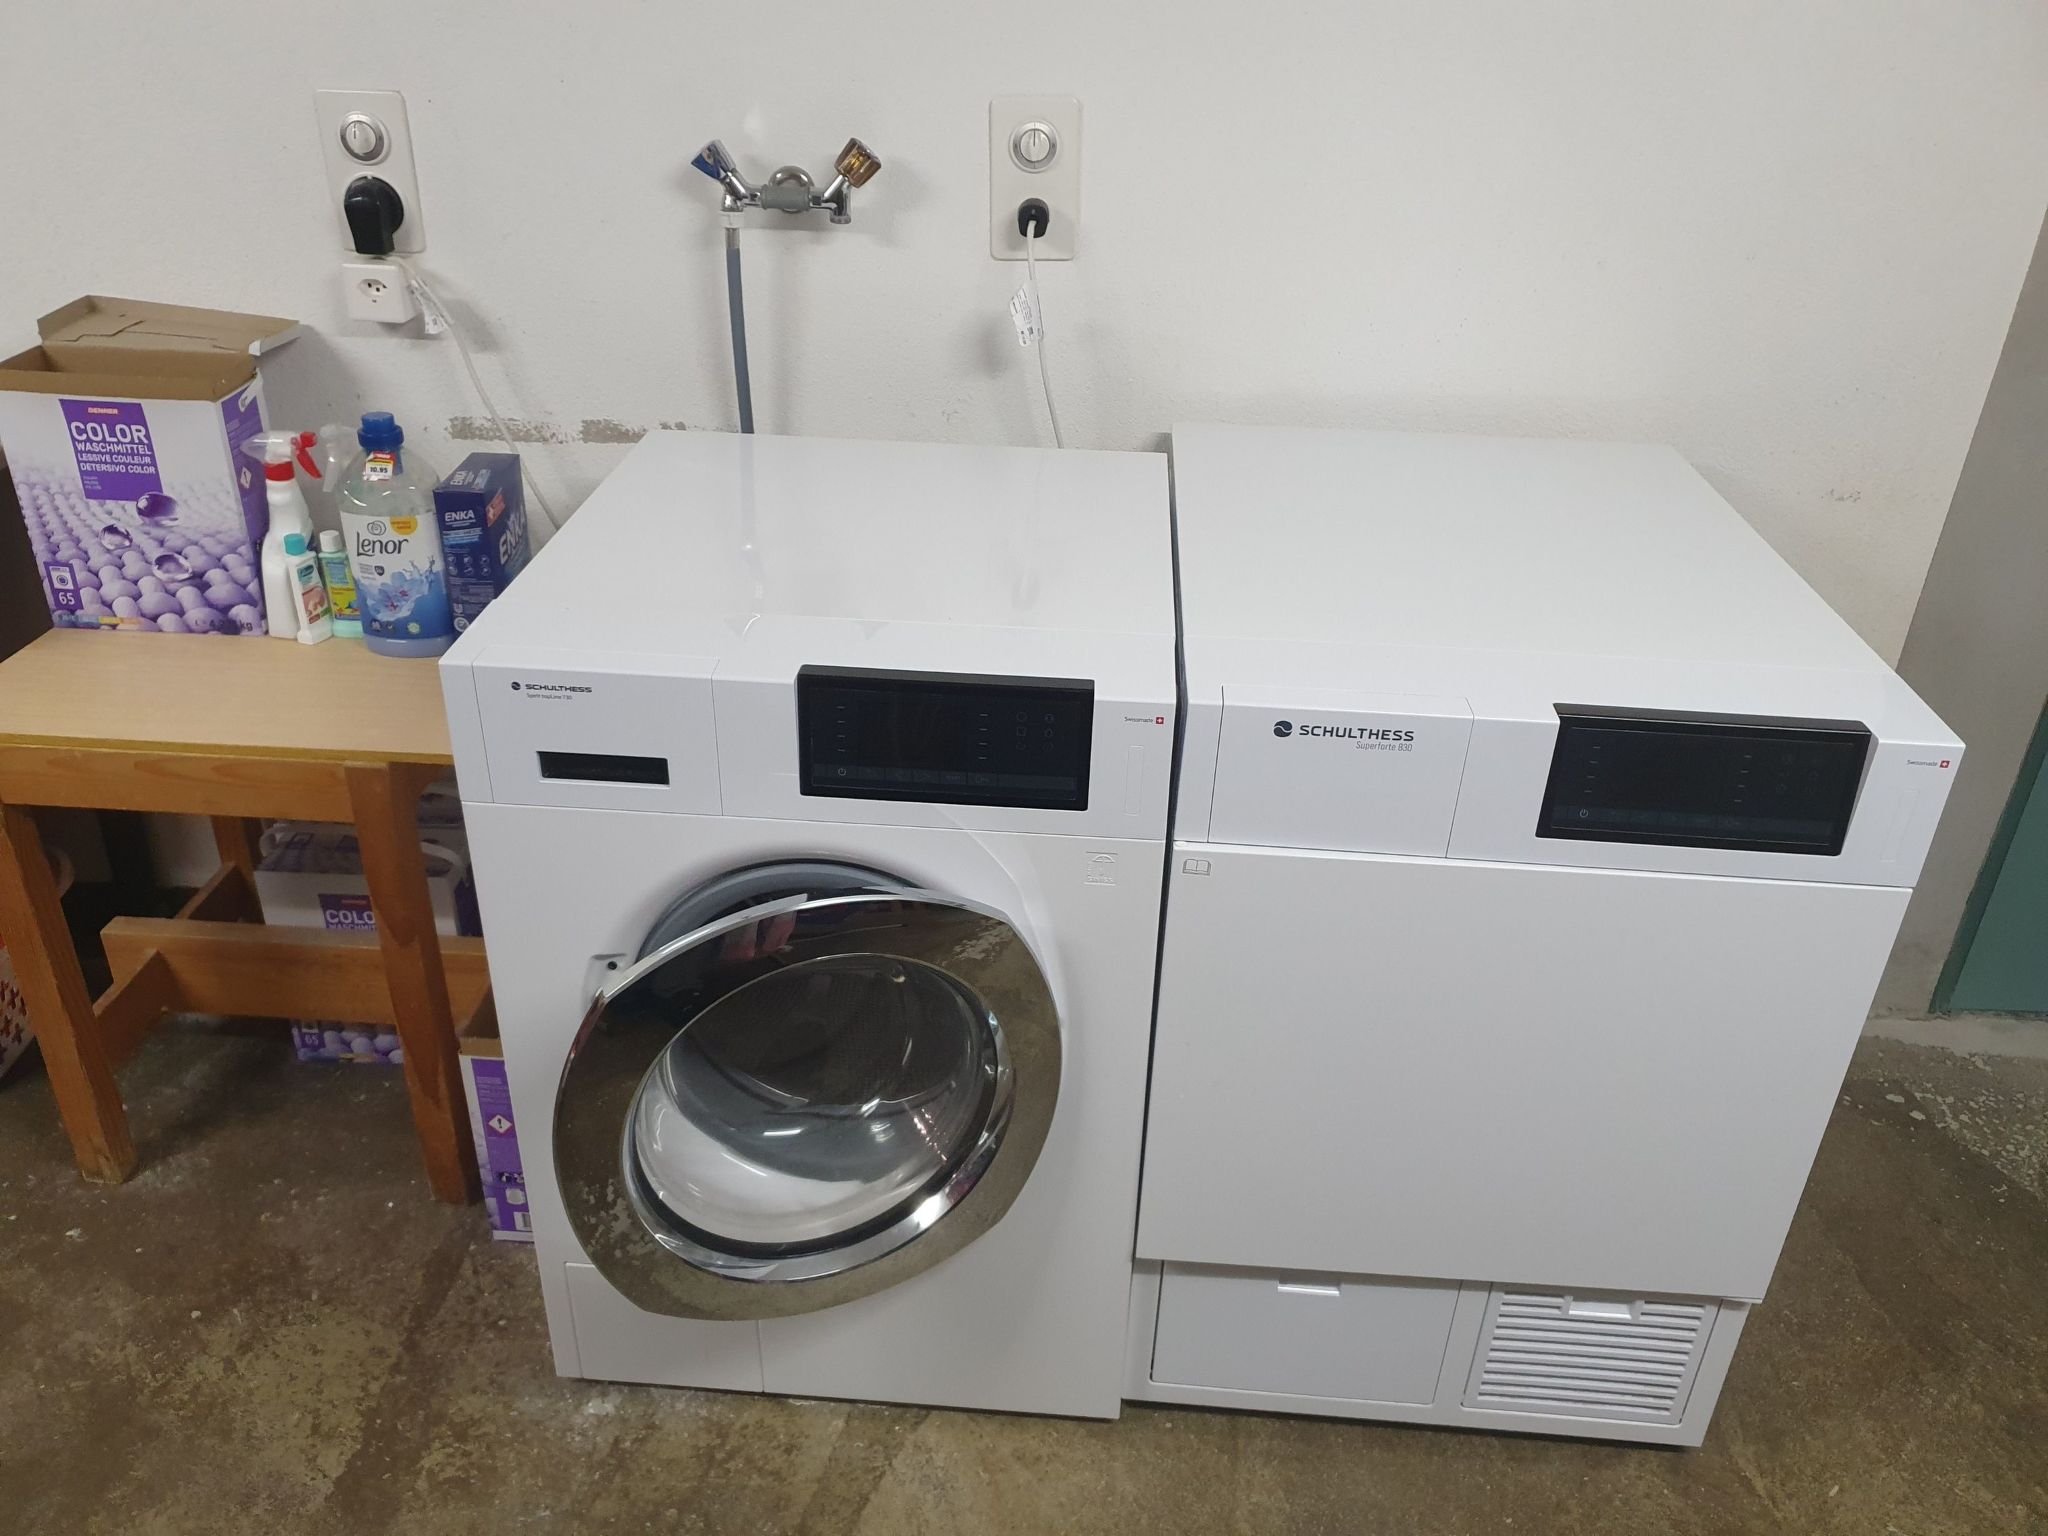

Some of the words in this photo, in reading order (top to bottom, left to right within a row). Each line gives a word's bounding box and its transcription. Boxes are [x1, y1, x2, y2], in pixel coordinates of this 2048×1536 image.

[70, 421, 149, 443] COLOR
[75, 441, 152, 454] WASCHMITTEL
[78, 453, 111, 463] LESSIVE
[112, 455, 151, 464] COULEUR
[80, 463, 126, 473] DETERSIVO
[127, 465, 156, 474] COLOR
[445, 510, 475, 521] ENKA
[356, 531, 409, 557] Lenor
[58, 592, 76, 605] 65
[240, 619, 253, 632] kg
[525, 683, 593, 693] SCHULTHESS
[1299, 725, 1415, 742] SCHULTHESS
[1355, 741, 1396, 752] Superforte
[1397, 742, 1413, 752] 830
[326, 909, 375, 924] COLO
